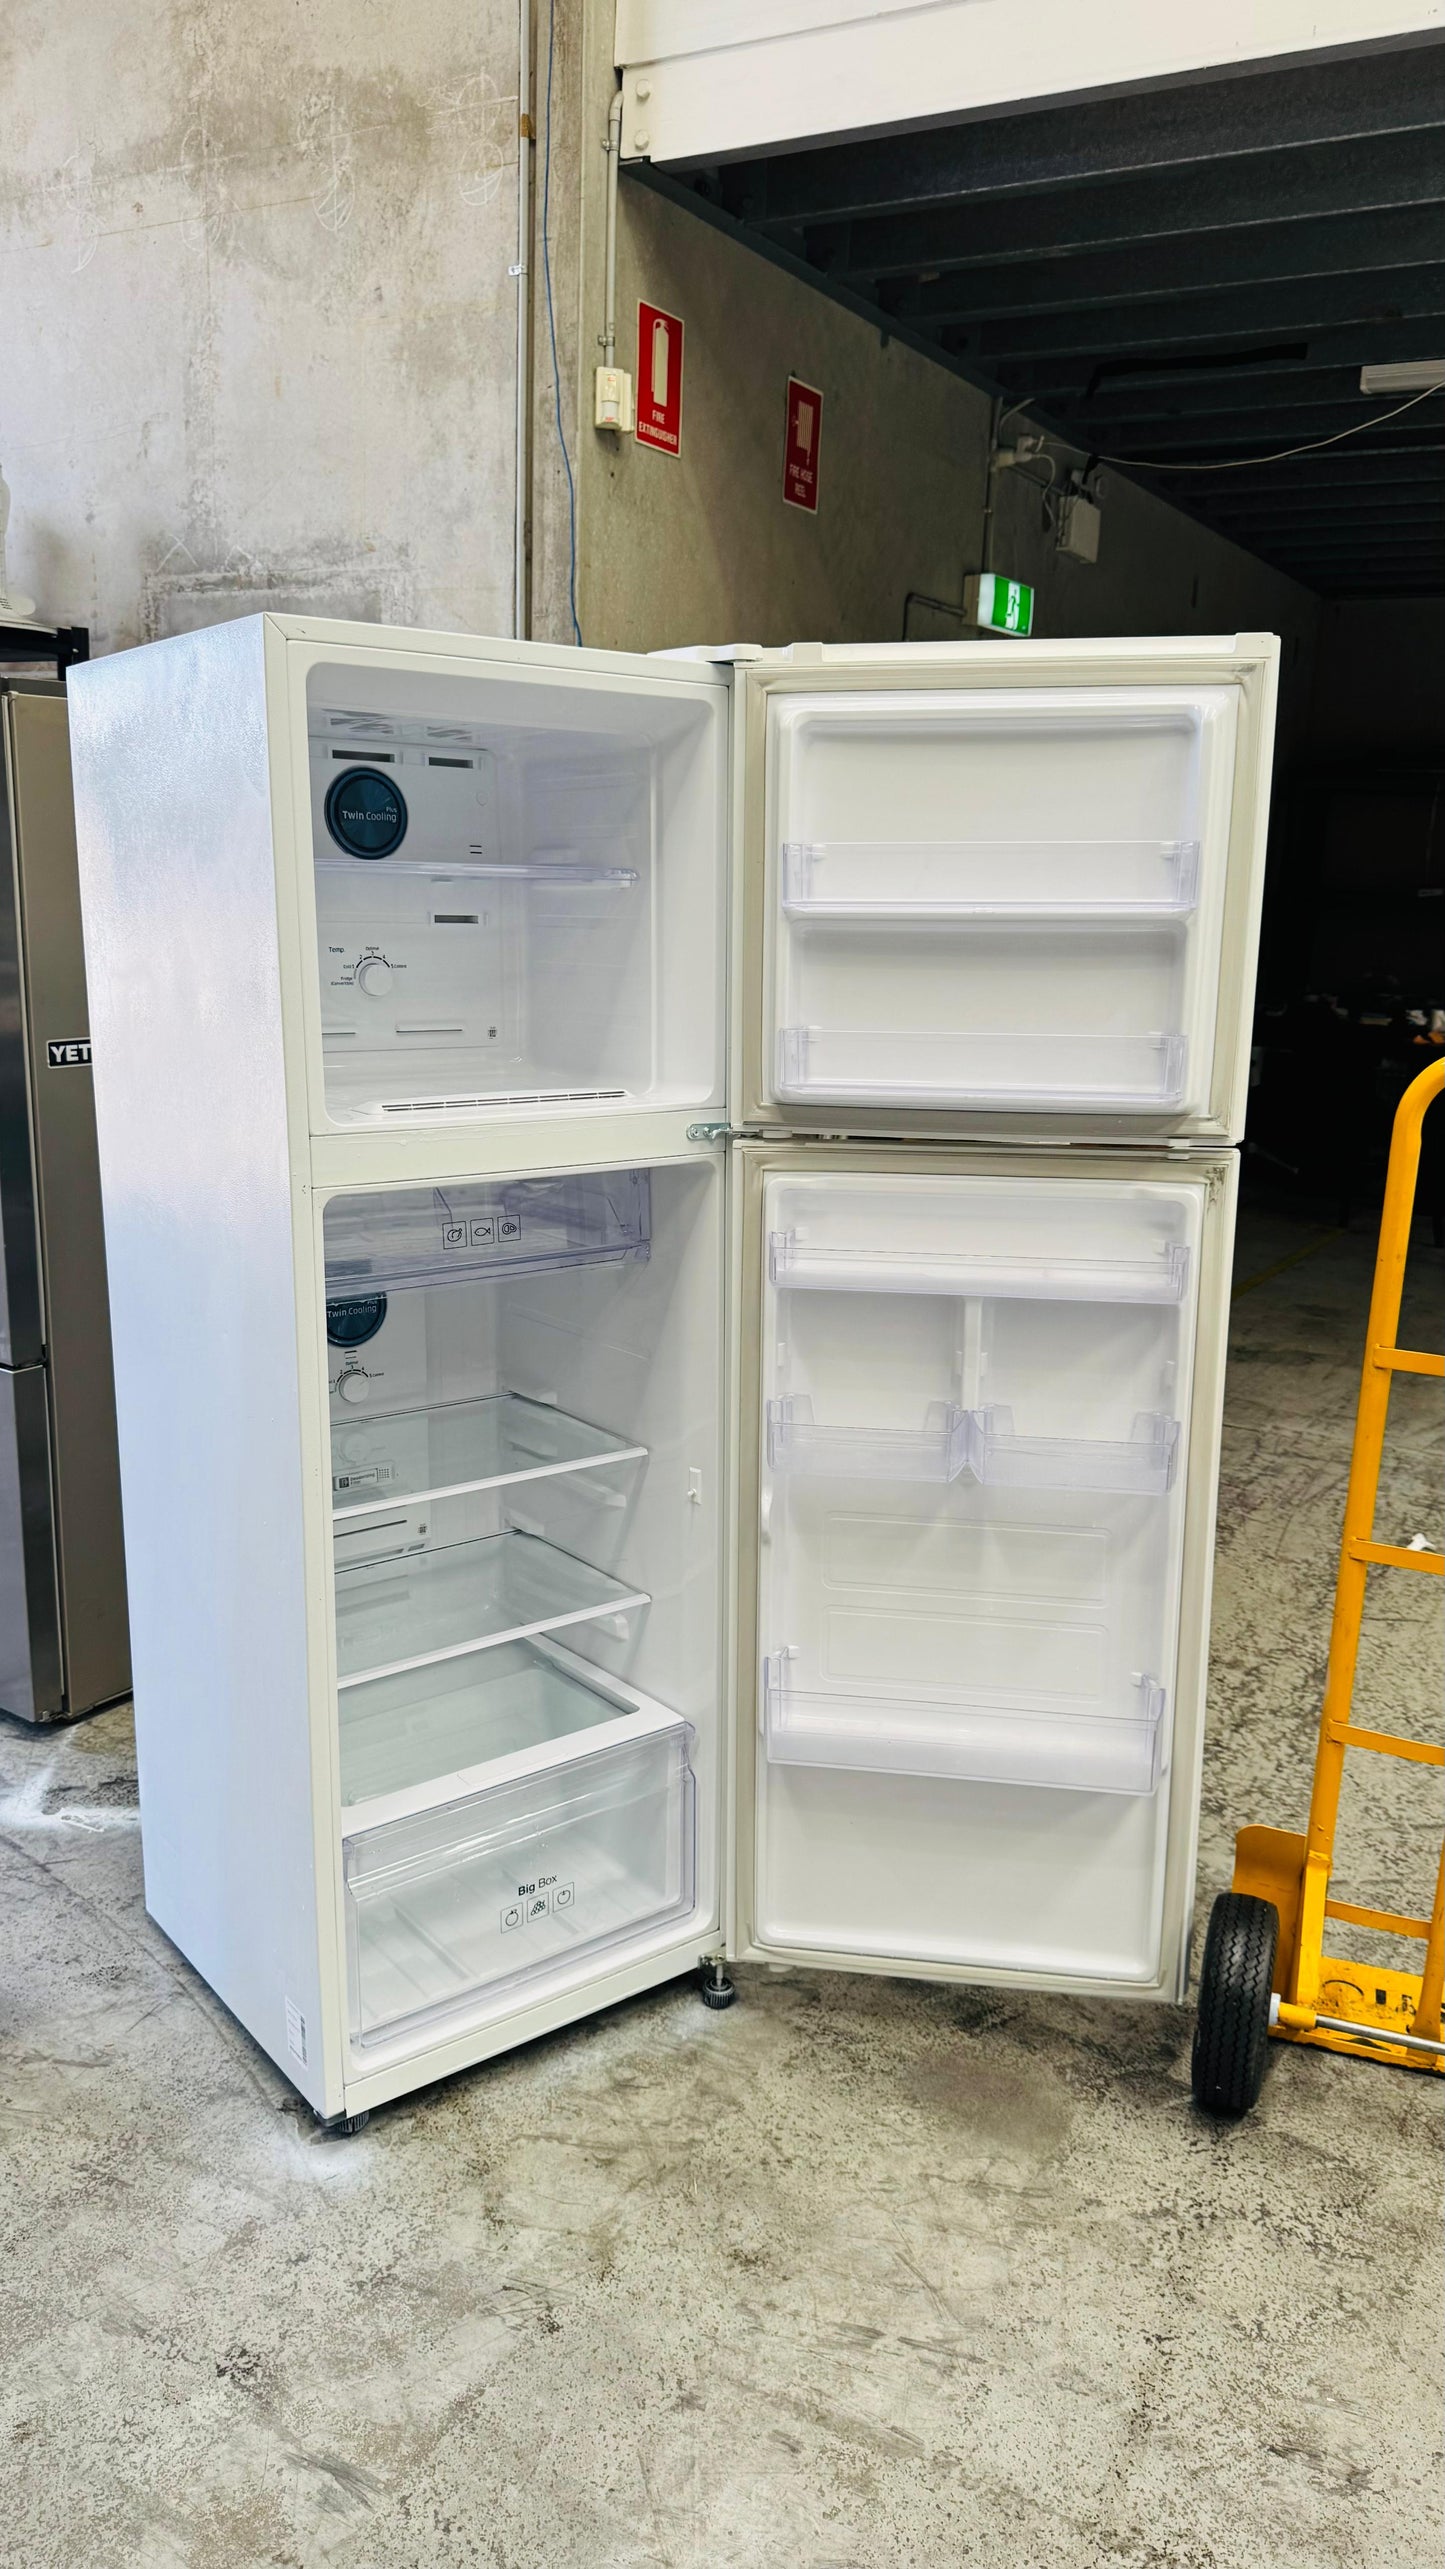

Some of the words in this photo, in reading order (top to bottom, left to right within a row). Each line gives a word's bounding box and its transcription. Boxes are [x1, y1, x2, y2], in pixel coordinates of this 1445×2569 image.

[652, 409, 665, 425] FIRE
[342, 810, 364, 820] Twin
[365, 811, 397, 823] Cooling
[327, 1309, 347, 1318] Twin
[348, 1305, 377, 1315] Cooling
[518, 1884, 535, 1896] Big
[538, 1875, 557, 1888] Box
